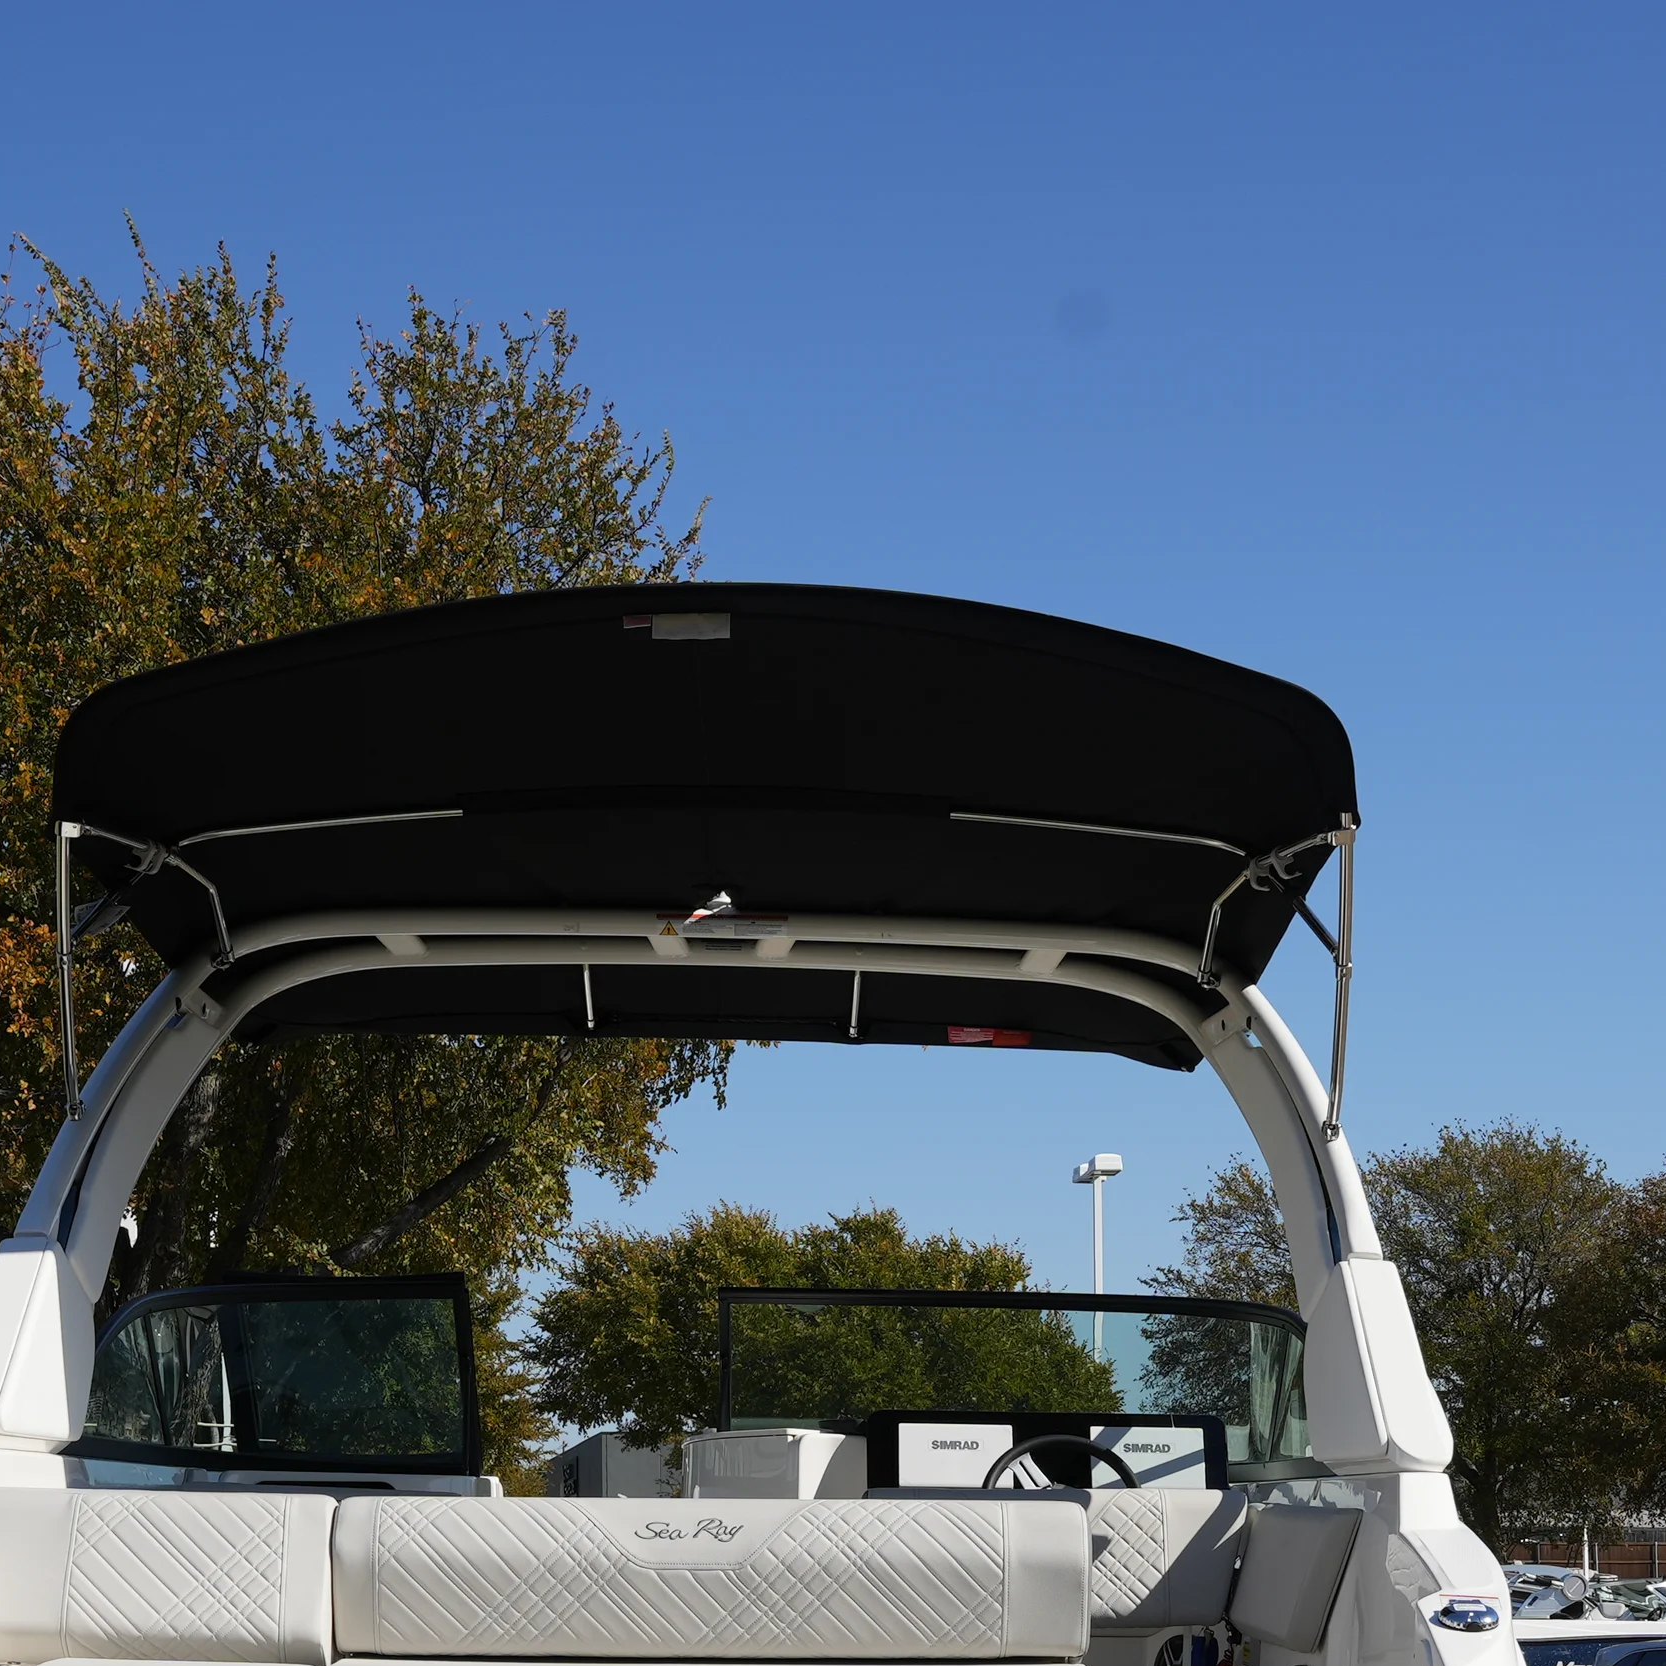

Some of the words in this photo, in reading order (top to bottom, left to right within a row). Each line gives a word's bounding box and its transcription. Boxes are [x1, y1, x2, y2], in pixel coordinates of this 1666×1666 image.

[931, 1439, 979, 1450] SIMRAD
[1123, 1443, 1170, 1453] SIMRAD
[635, 1521, 689, 1540] Sea
[693, 1518, 744, 1542] Ray
